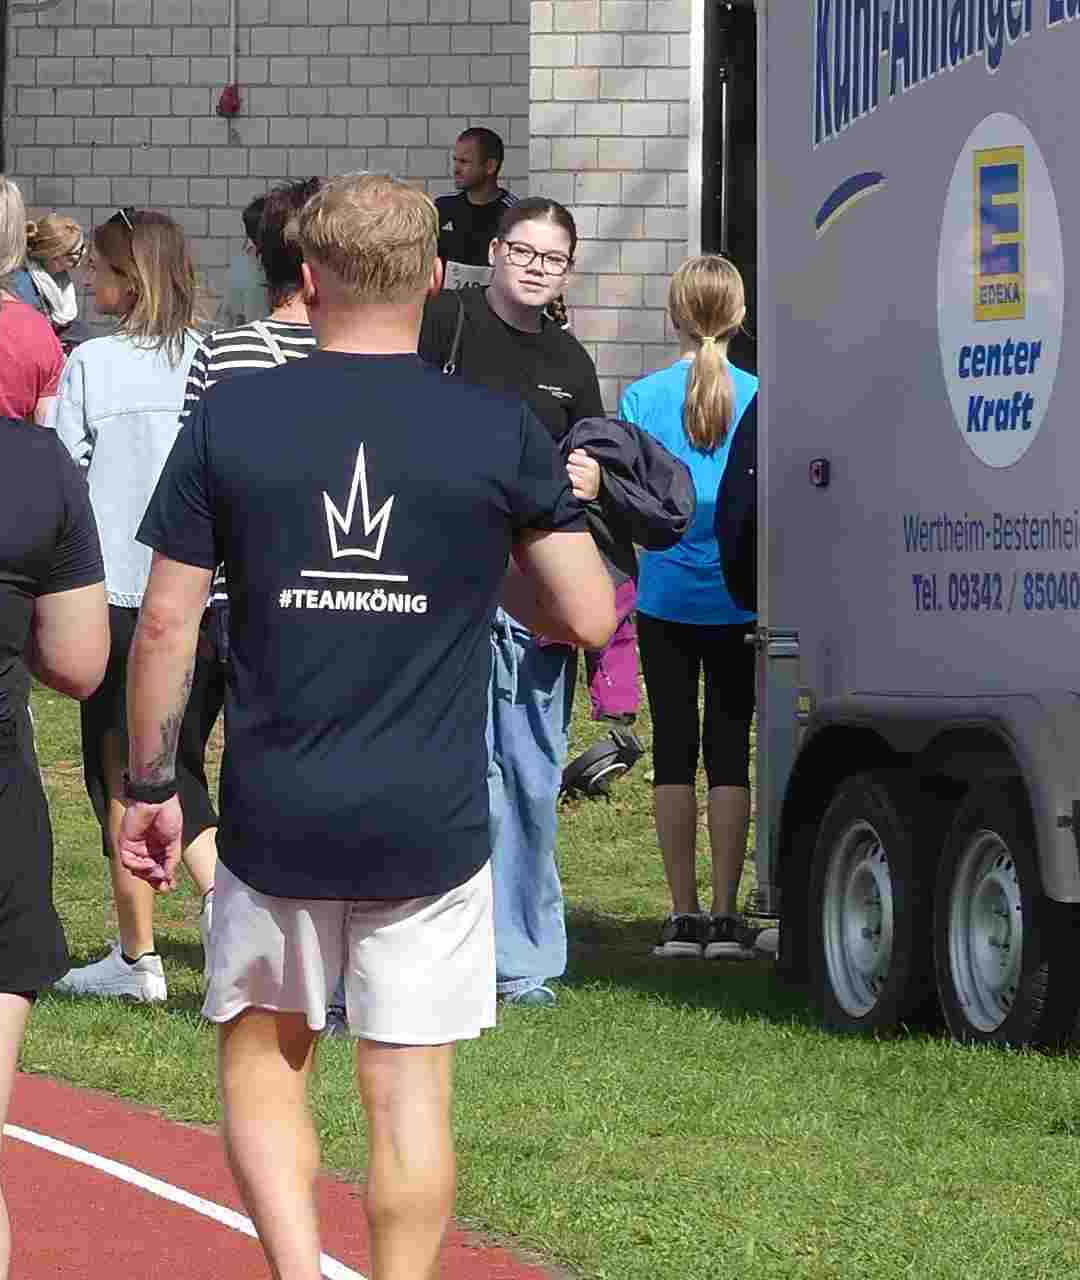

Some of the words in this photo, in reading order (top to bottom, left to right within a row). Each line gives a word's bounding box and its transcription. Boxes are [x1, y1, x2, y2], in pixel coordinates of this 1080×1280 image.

[980, 283, 1020, 304] EDEKA
[959, 337, 1042, 378] center
[967, 391, 1034, 433] Kraft
[279, 588, 428, 614] #TEAMKÖNIG
[912, 572, 943, 611] Tel.
[949, 572, 1002, 611] 09342
[1005, 572, 1017, 614] /
[1023, 572, 1080, 611] 85040
